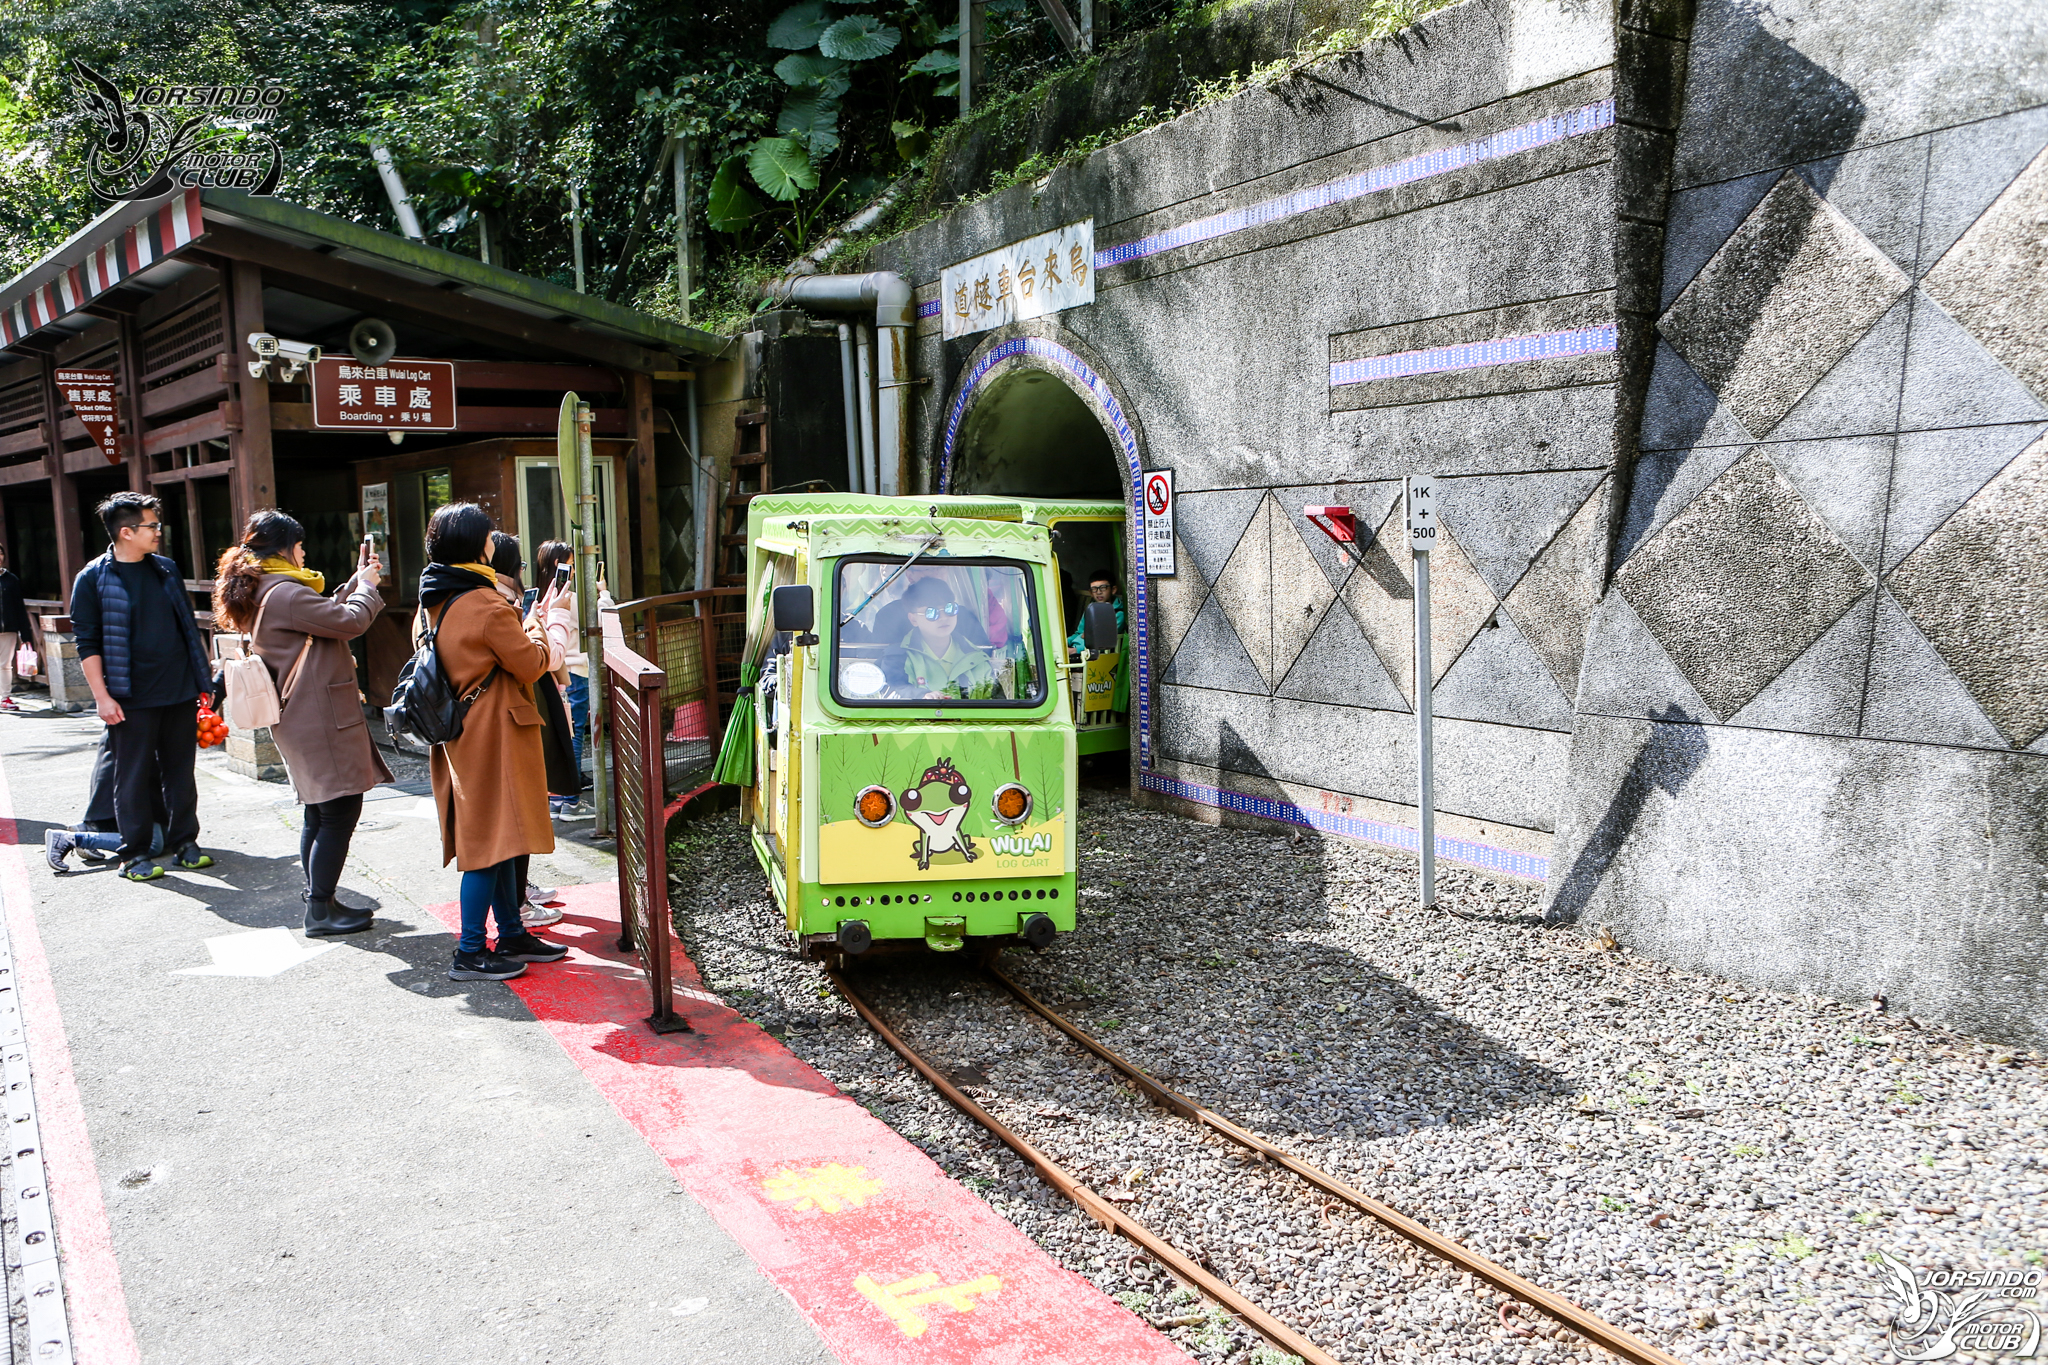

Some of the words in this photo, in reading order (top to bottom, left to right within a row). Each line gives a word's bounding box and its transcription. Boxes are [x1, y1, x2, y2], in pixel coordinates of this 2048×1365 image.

[389, 368, 406, 380] Wulai
[406, 370, 418, 383] Log
[418, 370, 432, 381] Cart
[339, 411, 383, 423] Boarding
[104, 438, 115, 446] 80
[1413, 487, 1430, 498] 1K
[1148, 518, 1170, 528] 禁止行人
[1413, 527, 1436, 539] 500
[1087, 680, 1112, 694] WULAI
[990, 832, 1052, 856] WULAI
[996, 860, 1018, 869] LOG
[1022, 858, 1050, 868] CART
